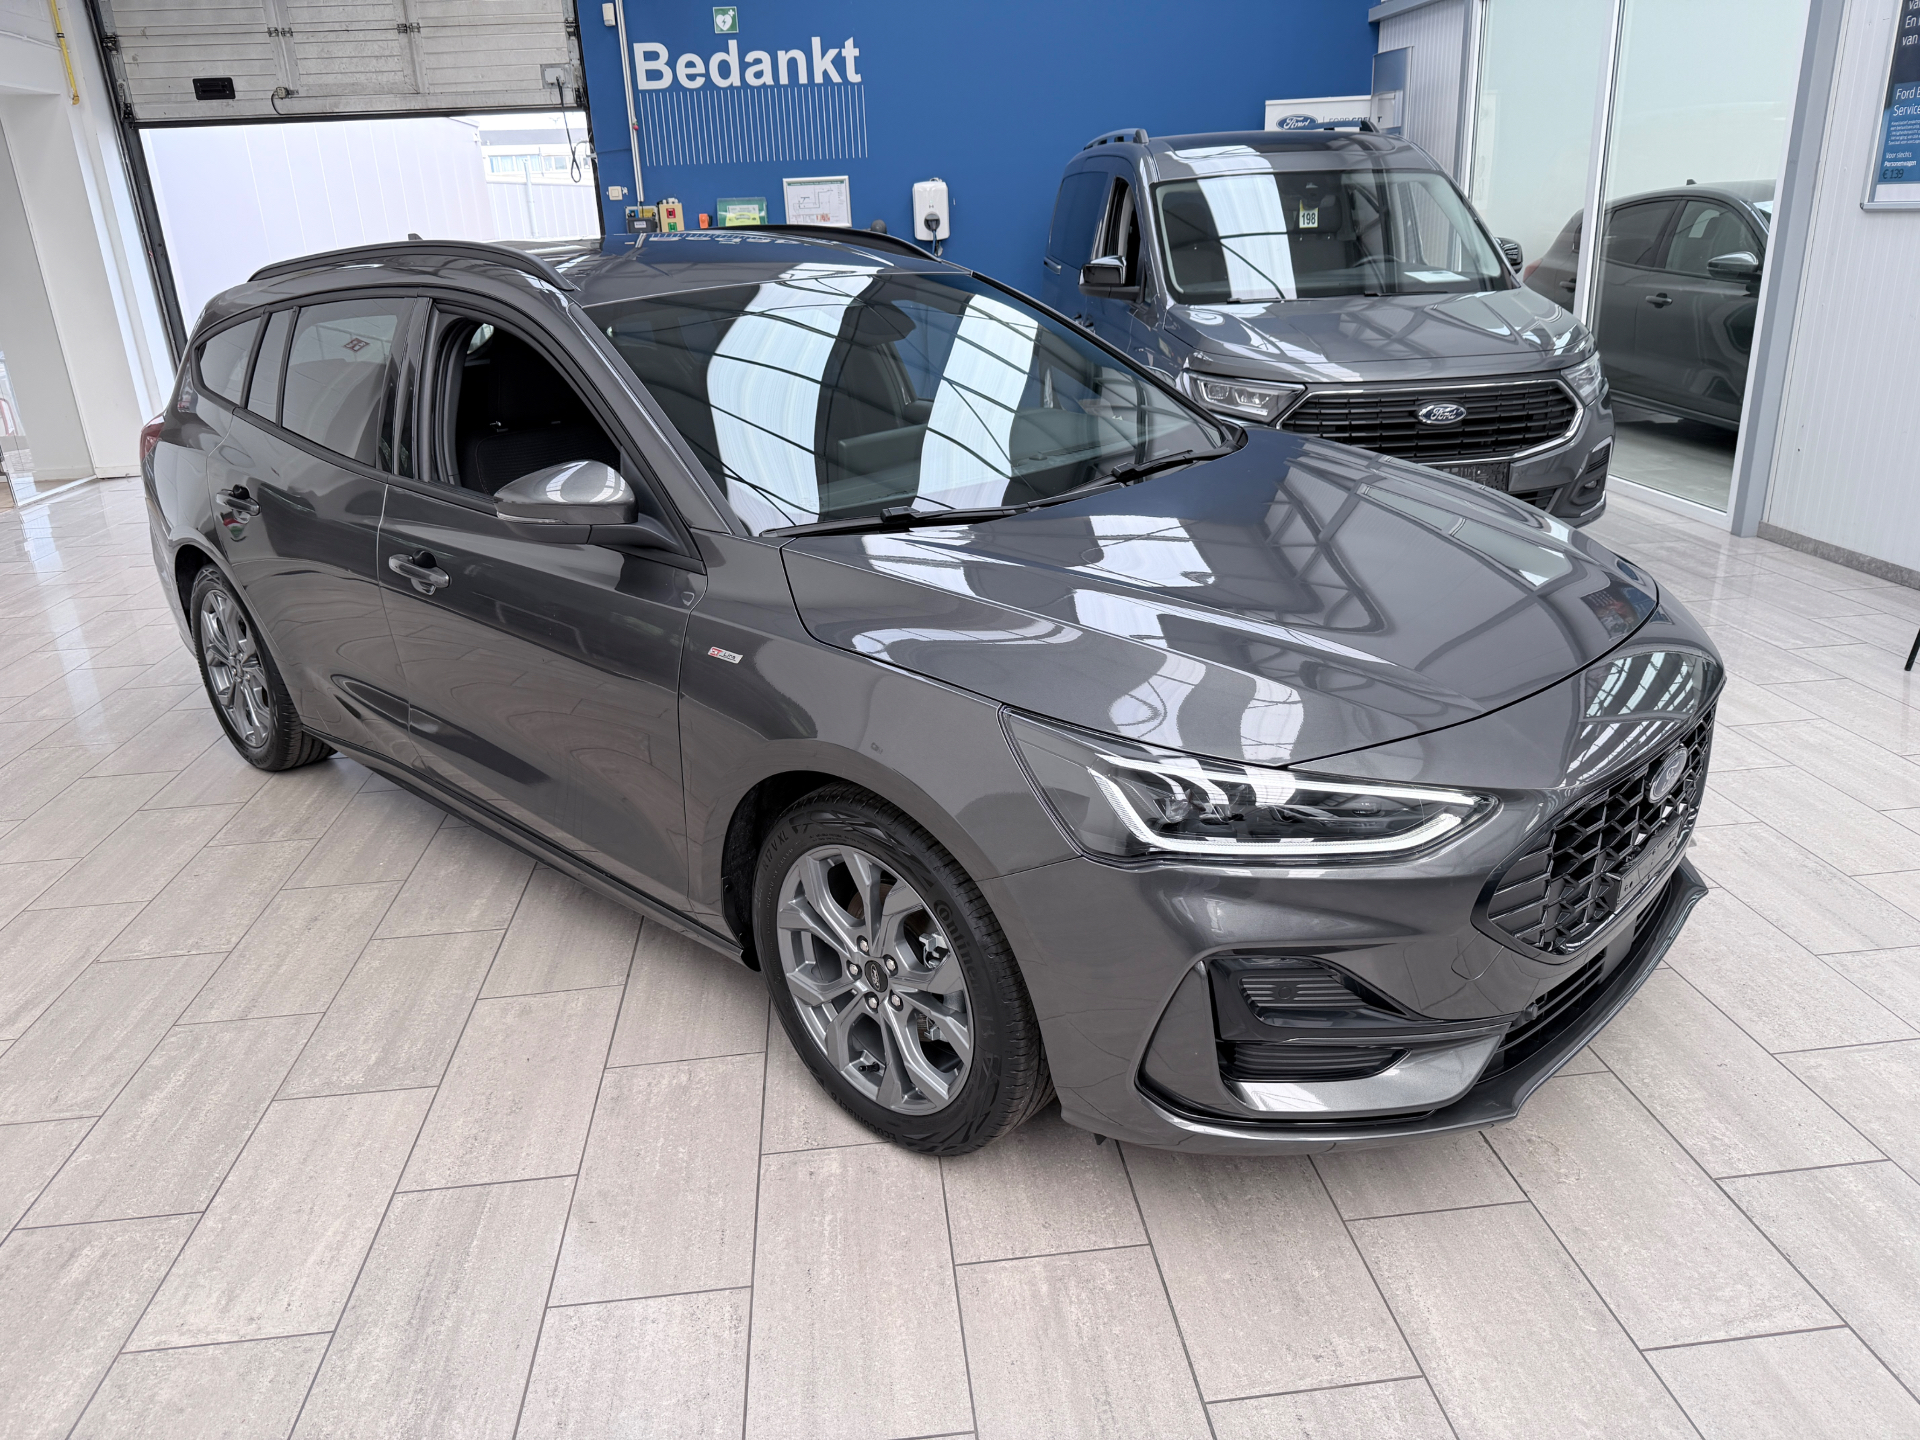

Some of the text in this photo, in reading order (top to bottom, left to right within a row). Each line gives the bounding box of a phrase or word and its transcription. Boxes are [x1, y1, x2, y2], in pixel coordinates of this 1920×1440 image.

[1909, 0, 1920, 10] va
[1905, 15, 1917, 28] En
[1902, 34, 1918, 46] van
[633, 36, 862, 90] Bedankt
[1896, 87, 1916, 100] Ford
[1893, 103, 1920, 116] Service
[1882, 168, 1904, 180] € 139
[1301, 212, 1316, 226] 198
